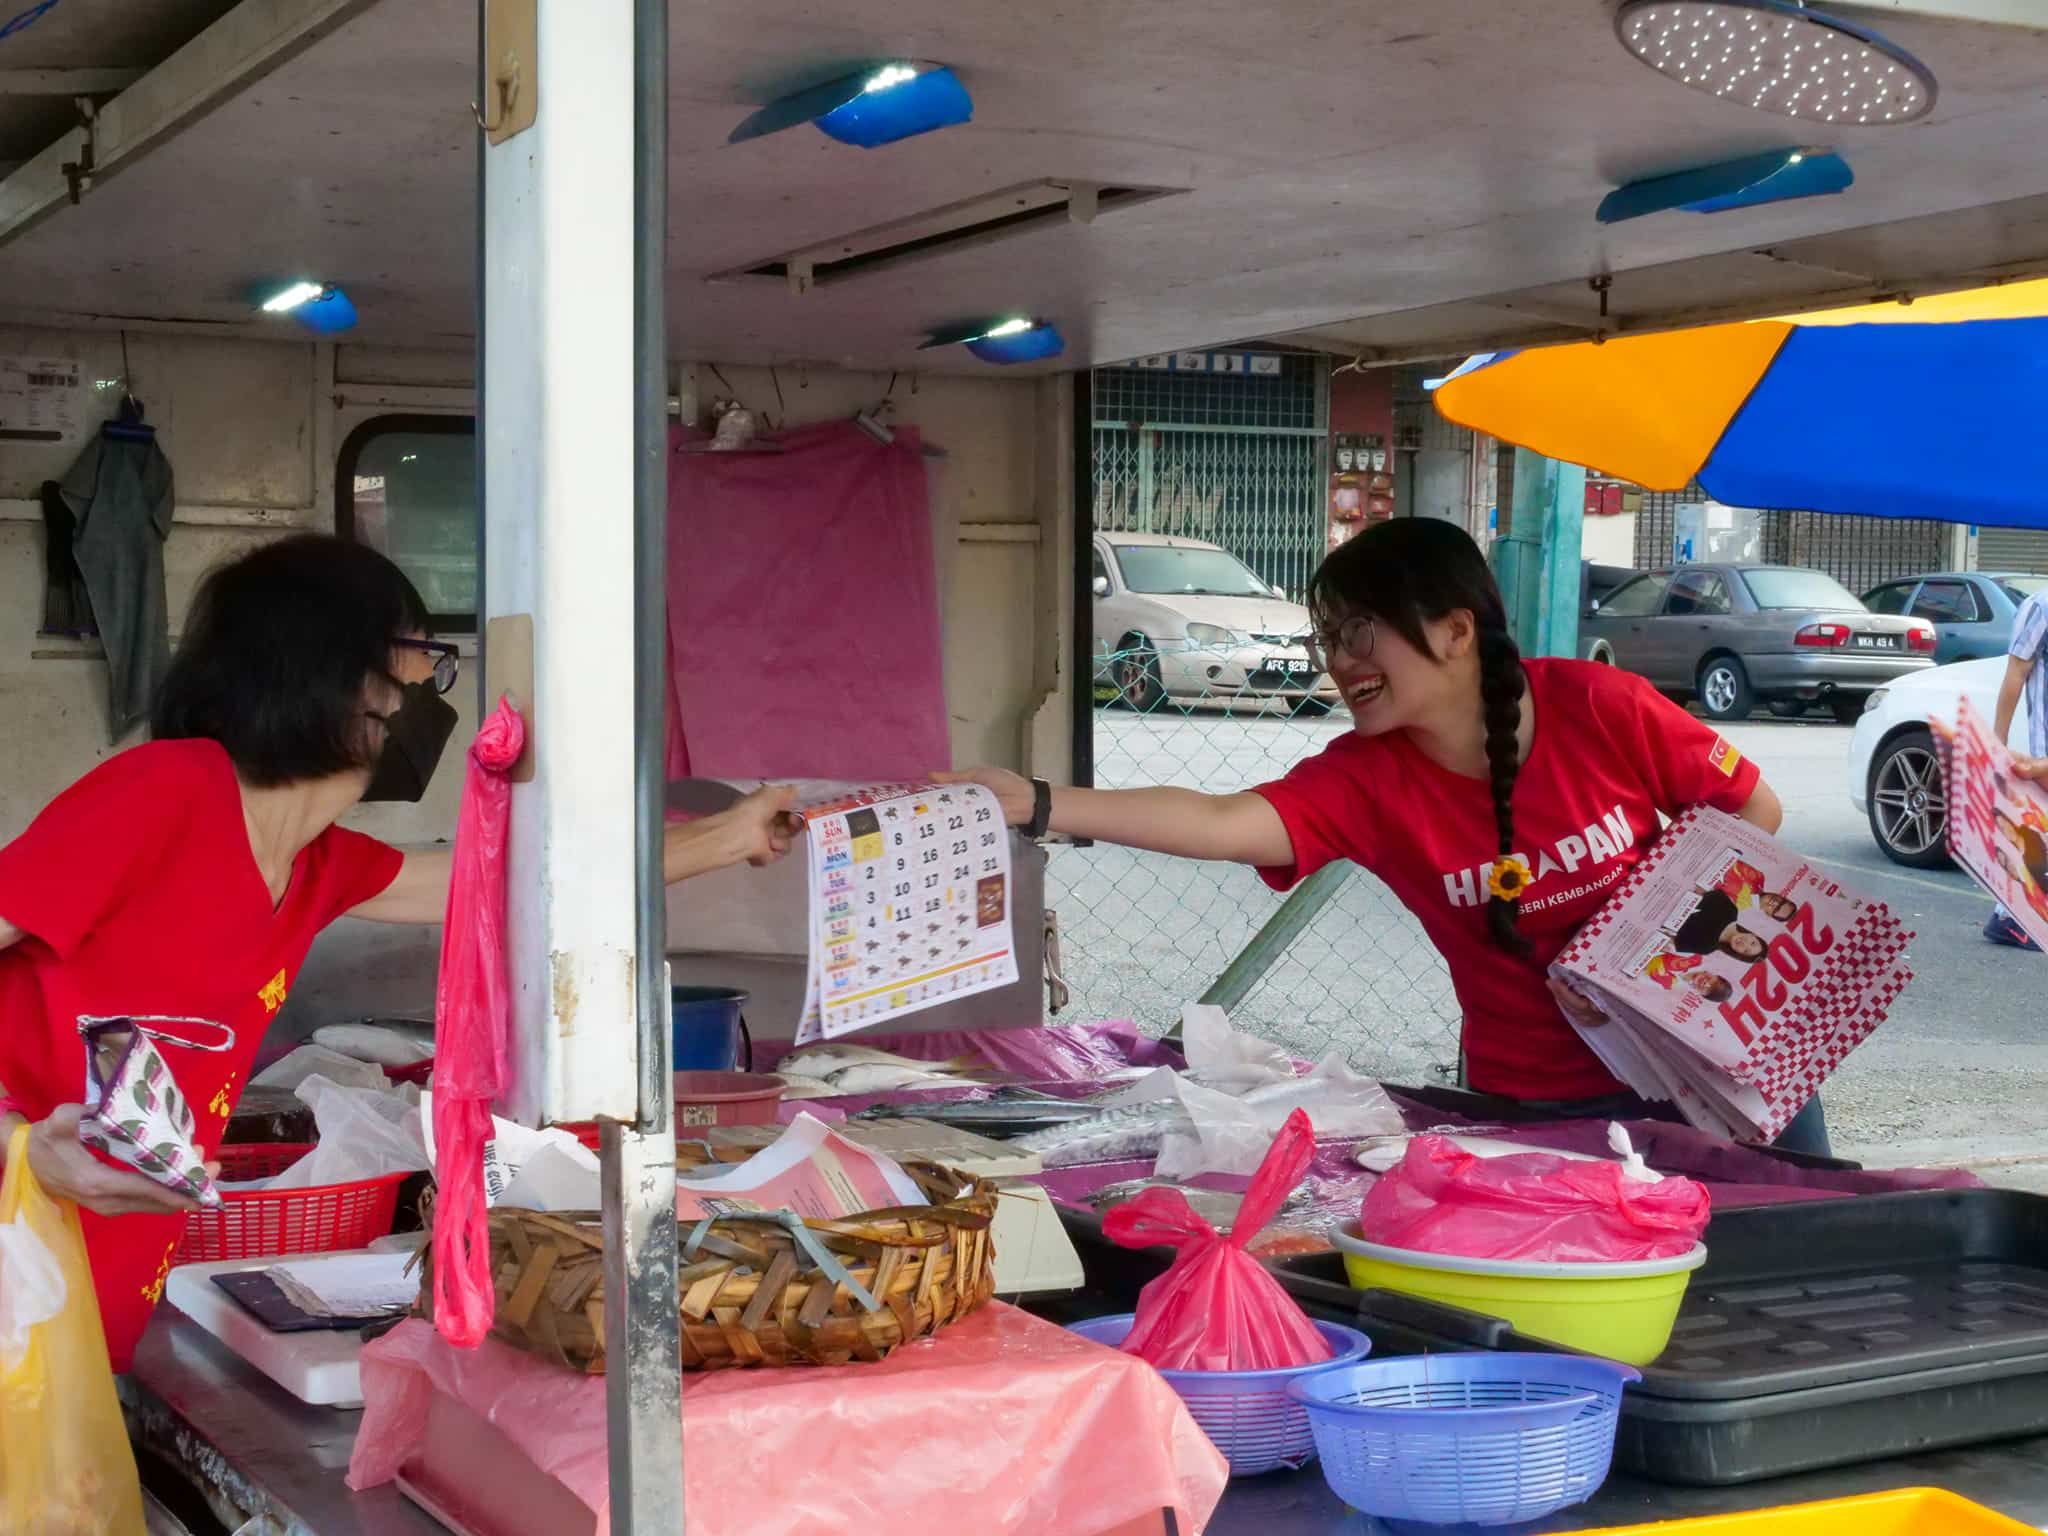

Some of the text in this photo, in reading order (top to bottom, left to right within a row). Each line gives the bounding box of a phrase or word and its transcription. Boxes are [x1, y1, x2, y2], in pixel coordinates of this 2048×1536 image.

[895, 832, 903, 846] 8
[919, 823, 936, 839] 15
[948, 815, 964, 830] 22
[975, 807, 991, 822] 29
[866, 866, 875, 879] 2
[897, 857, 905, 871] 9
[922, 848, 938, 864] 16
[952, 840, 968, 855] 23
[866, 891, 875, 904] 3
[895, 881, 911, 897] 10
[924, 873, 939, 888] 17
[954, 865, 969, 880] 24
[1517, 899, 1545, 915] SERI
[1548, 863, 1623, 908] KEMBANGAN
[868, 916, 876, 928] 4
[895, 906, 912, 922] 11
[1717, 901, 1834, 1048] 2024
